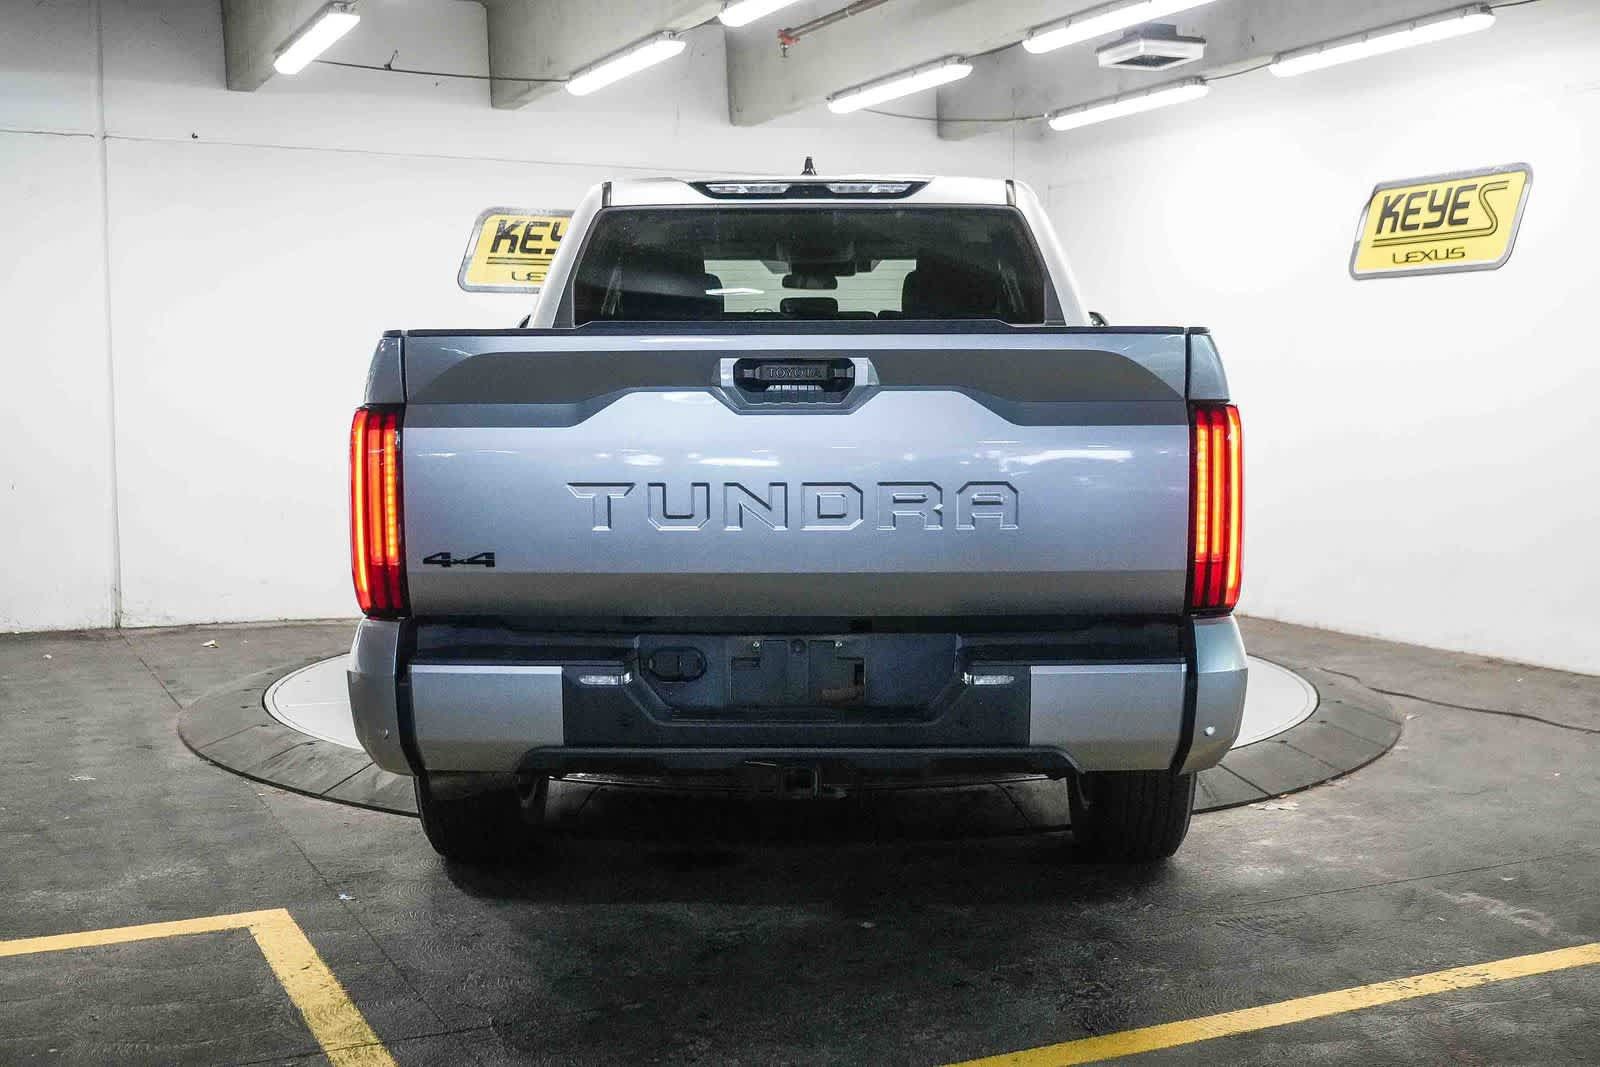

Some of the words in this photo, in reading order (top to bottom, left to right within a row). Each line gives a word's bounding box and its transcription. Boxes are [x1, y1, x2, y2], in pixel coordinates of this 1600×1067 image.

[1376, 180, 1510, 236] KEYES
[1392, 246, 1466, 265] LEXUS
[769, 366, 824, 379] TOYOTA
[565, 481, 1020, 532] TUNDRA
